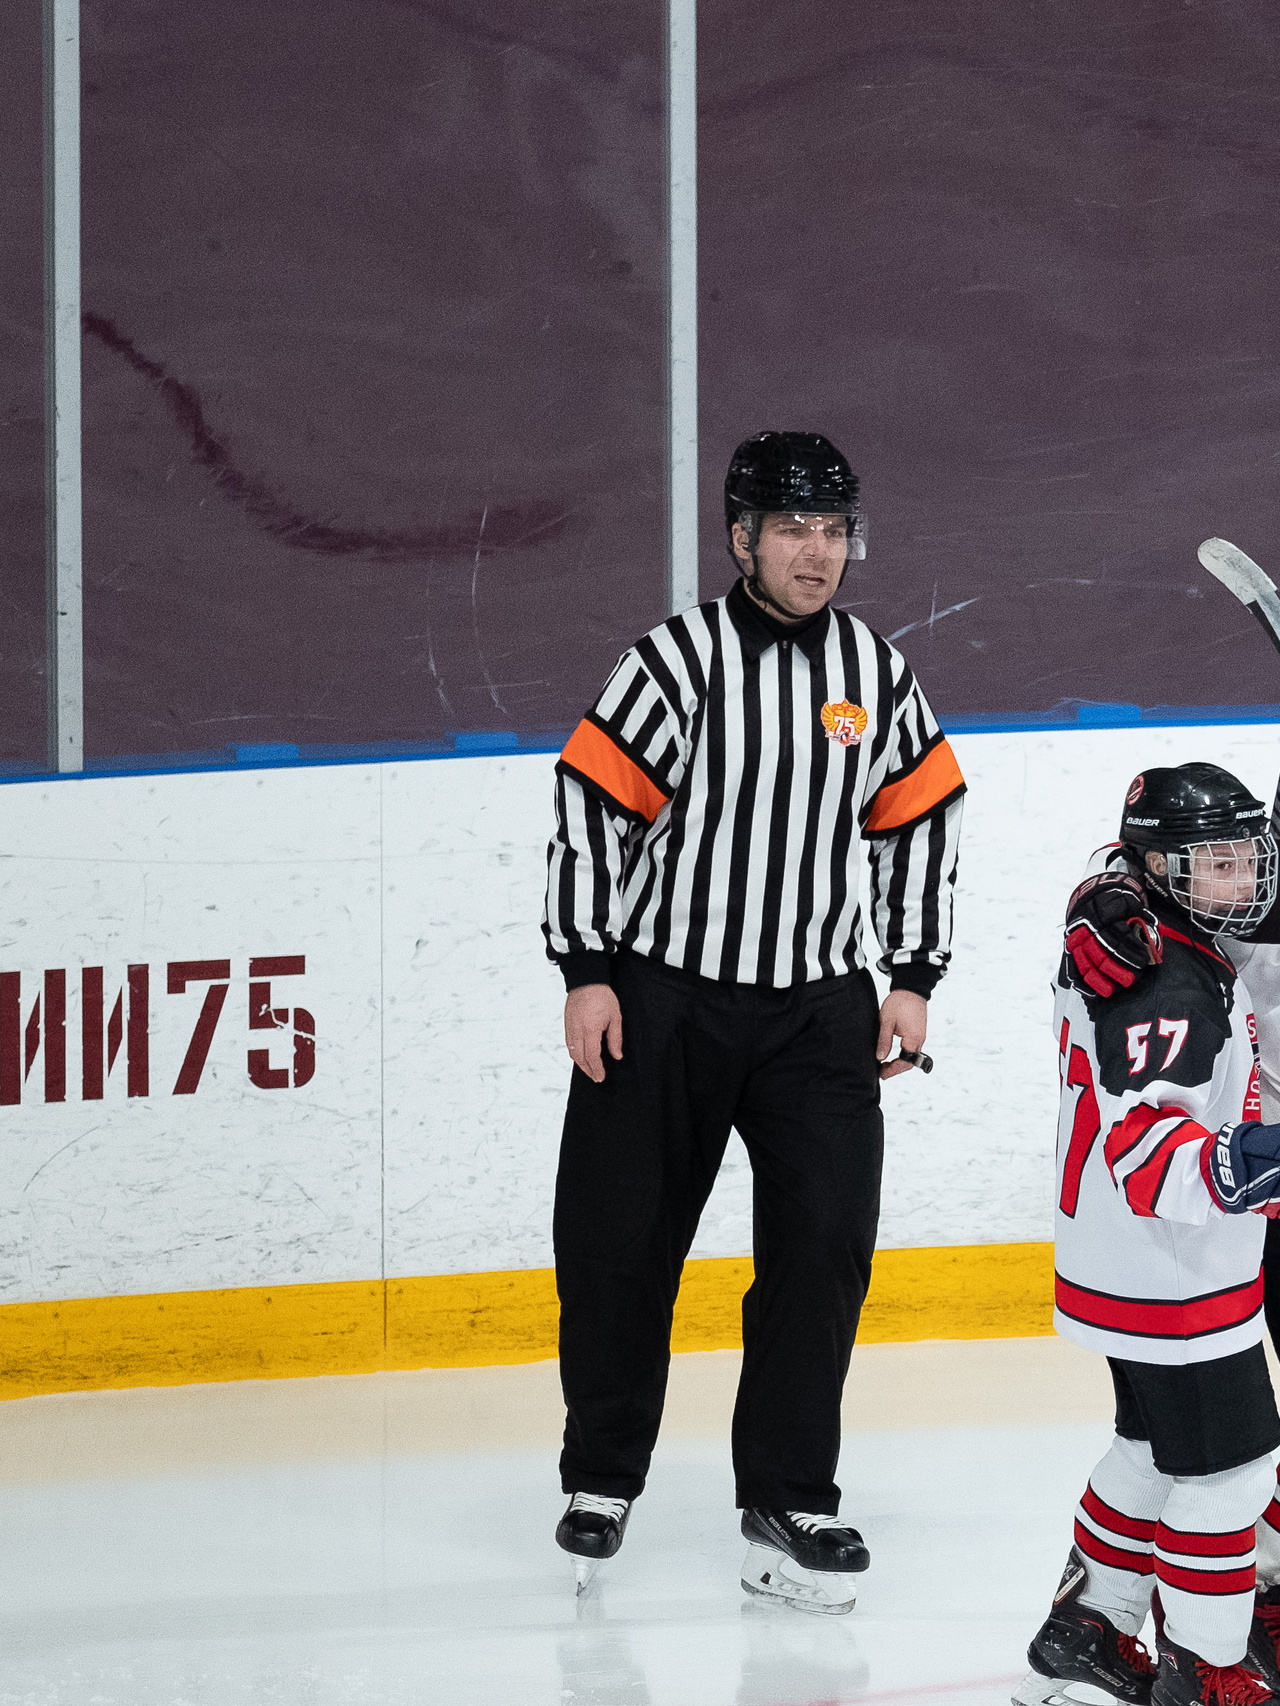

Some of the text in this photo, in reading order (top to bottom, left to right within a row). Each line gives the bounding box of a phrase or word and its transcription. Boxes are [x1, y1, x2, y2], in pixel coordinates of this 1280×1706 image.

[834, 715, 856, 737] 75
[1126, 817, 1161, 827] BAUER
[1235, 809, 1264, 820] BAUER
[1125, 1017, 1189, 1076] 57
